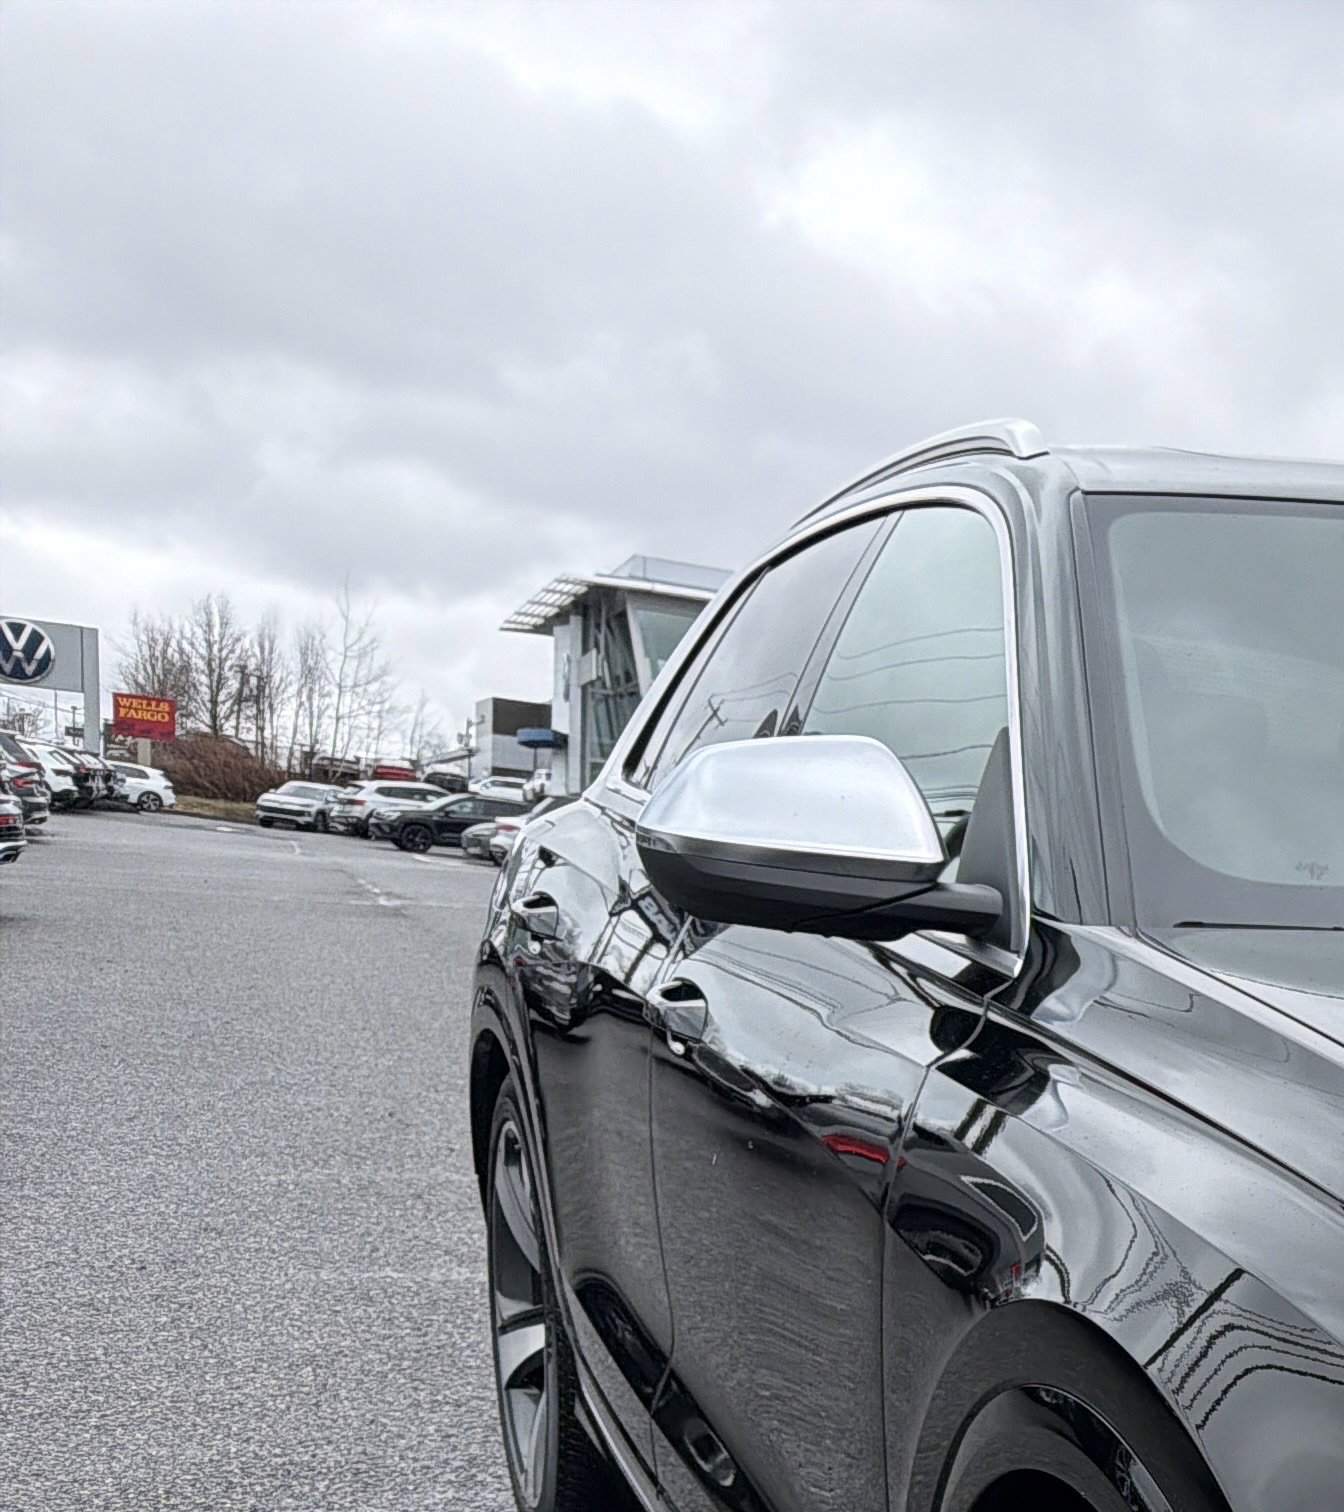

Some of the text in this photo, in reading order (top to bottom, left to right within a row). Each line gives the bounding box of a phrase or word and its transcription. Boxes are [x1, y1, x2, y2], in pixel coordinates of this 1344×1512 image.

[0, 619, 55, 682] VW
[117, 696, 170, 712] WELLS
[118, 707, 170, 723] FARGO
